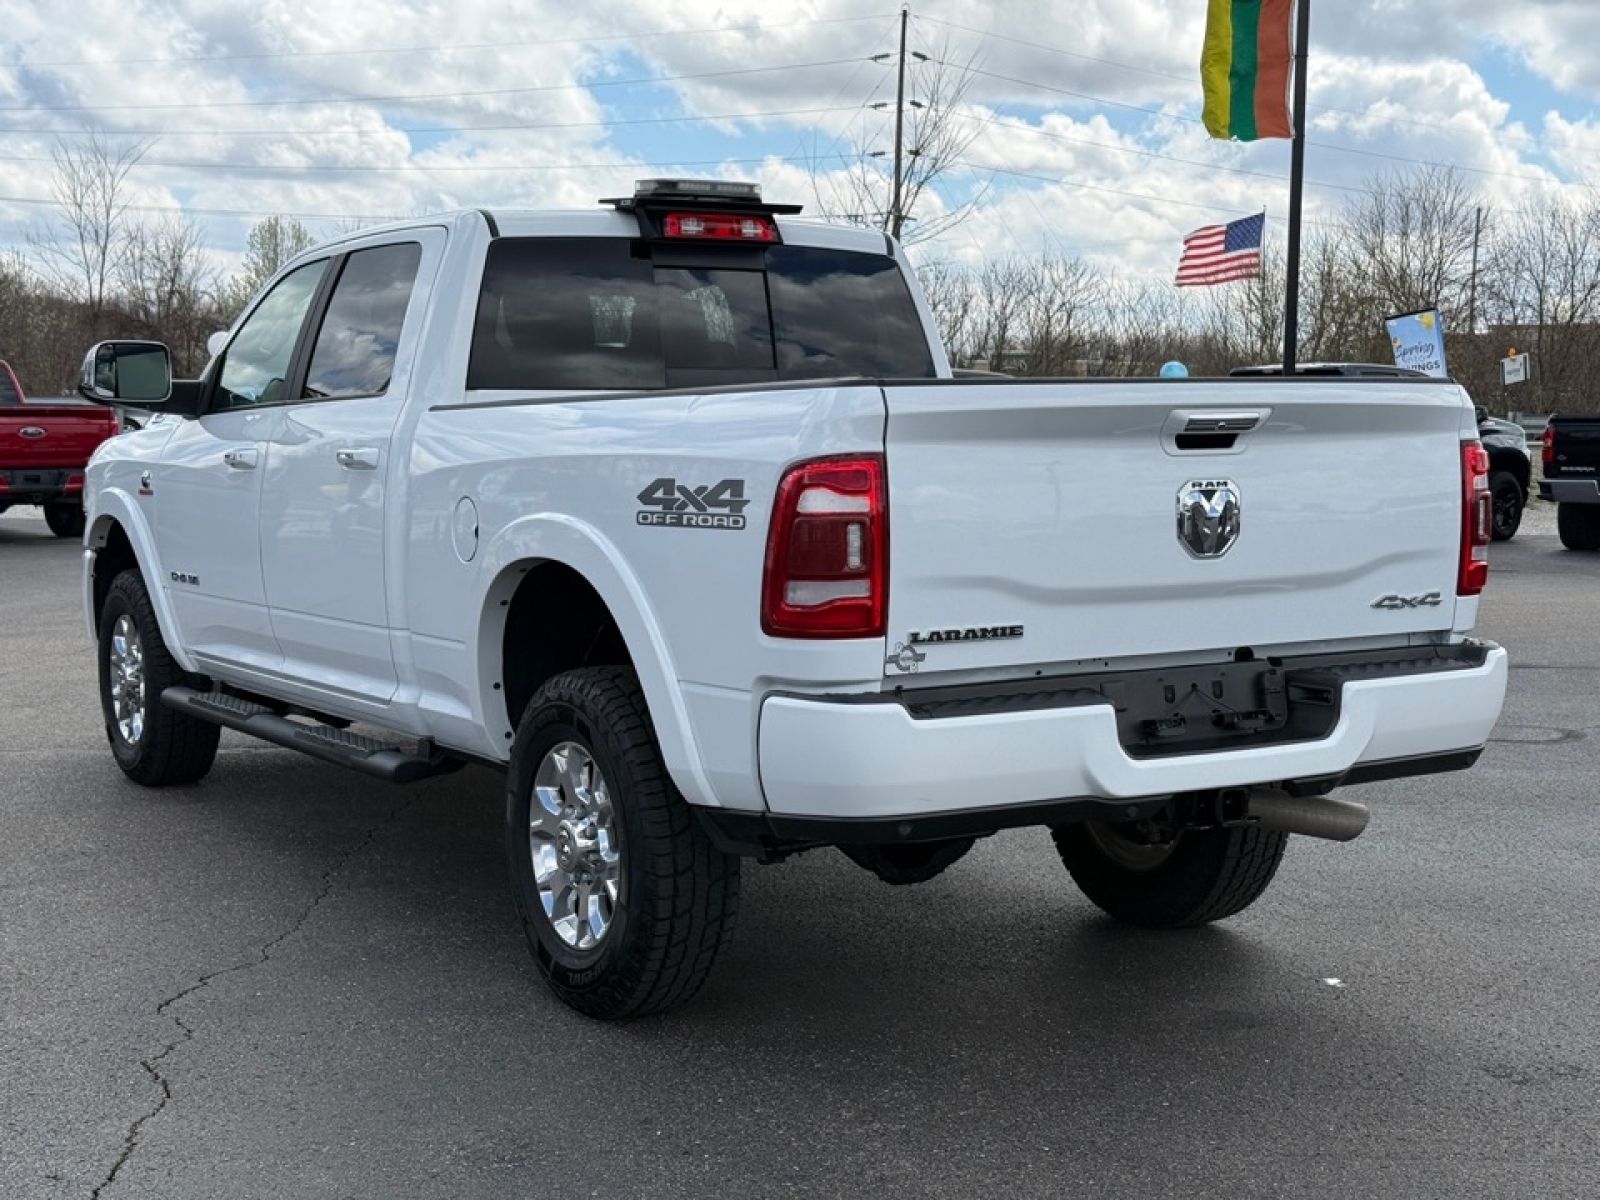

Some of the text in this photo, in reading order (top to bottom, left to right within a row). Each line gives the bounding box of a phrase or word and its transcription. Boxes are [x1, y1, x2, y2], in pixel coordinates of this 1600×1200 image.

[1395, 341, 1435, 360] Spring
[1191, 481, 1228, 489] RAM
[639, 512, 744, 528] OFF ROAD
[908, 625, 1024, 645] LARAMIE
